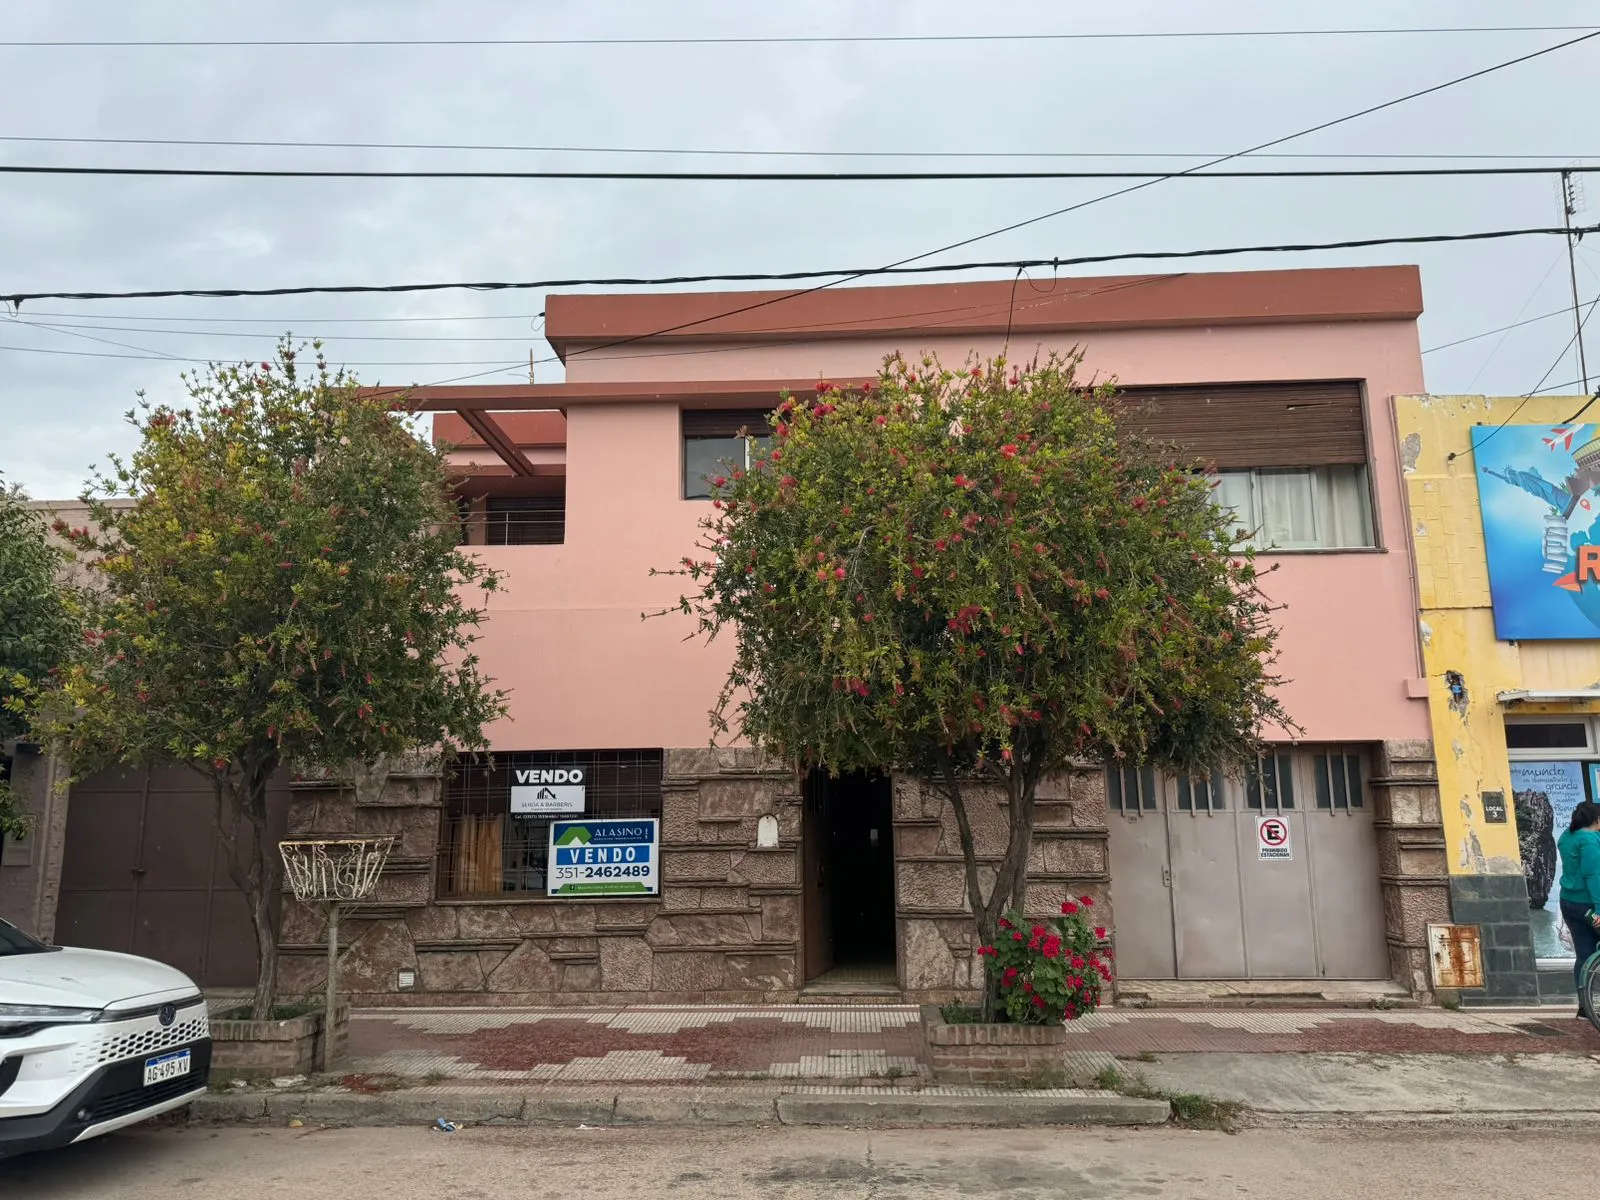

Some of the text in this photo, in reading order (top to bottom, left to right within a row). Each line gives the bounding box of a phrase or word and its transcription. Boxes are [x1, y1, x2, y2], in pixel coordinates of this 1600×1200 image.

[515, 769, 583, 784] VENDO
[1522, 763, 1565, 776] mundo
[1545, 781, 1578, 795] grande
[594, 827, 643, 837] ALASINO
[1267, 825, 1279, 840] E
[570, 847, 636, 864] VENDO
[555, 865, 651, 879] 351-2462489
[147, 1066, 157, 1083] AG
[159, 1061, 175, 1078] 495
[177, 1057, 189, 1073] XV
